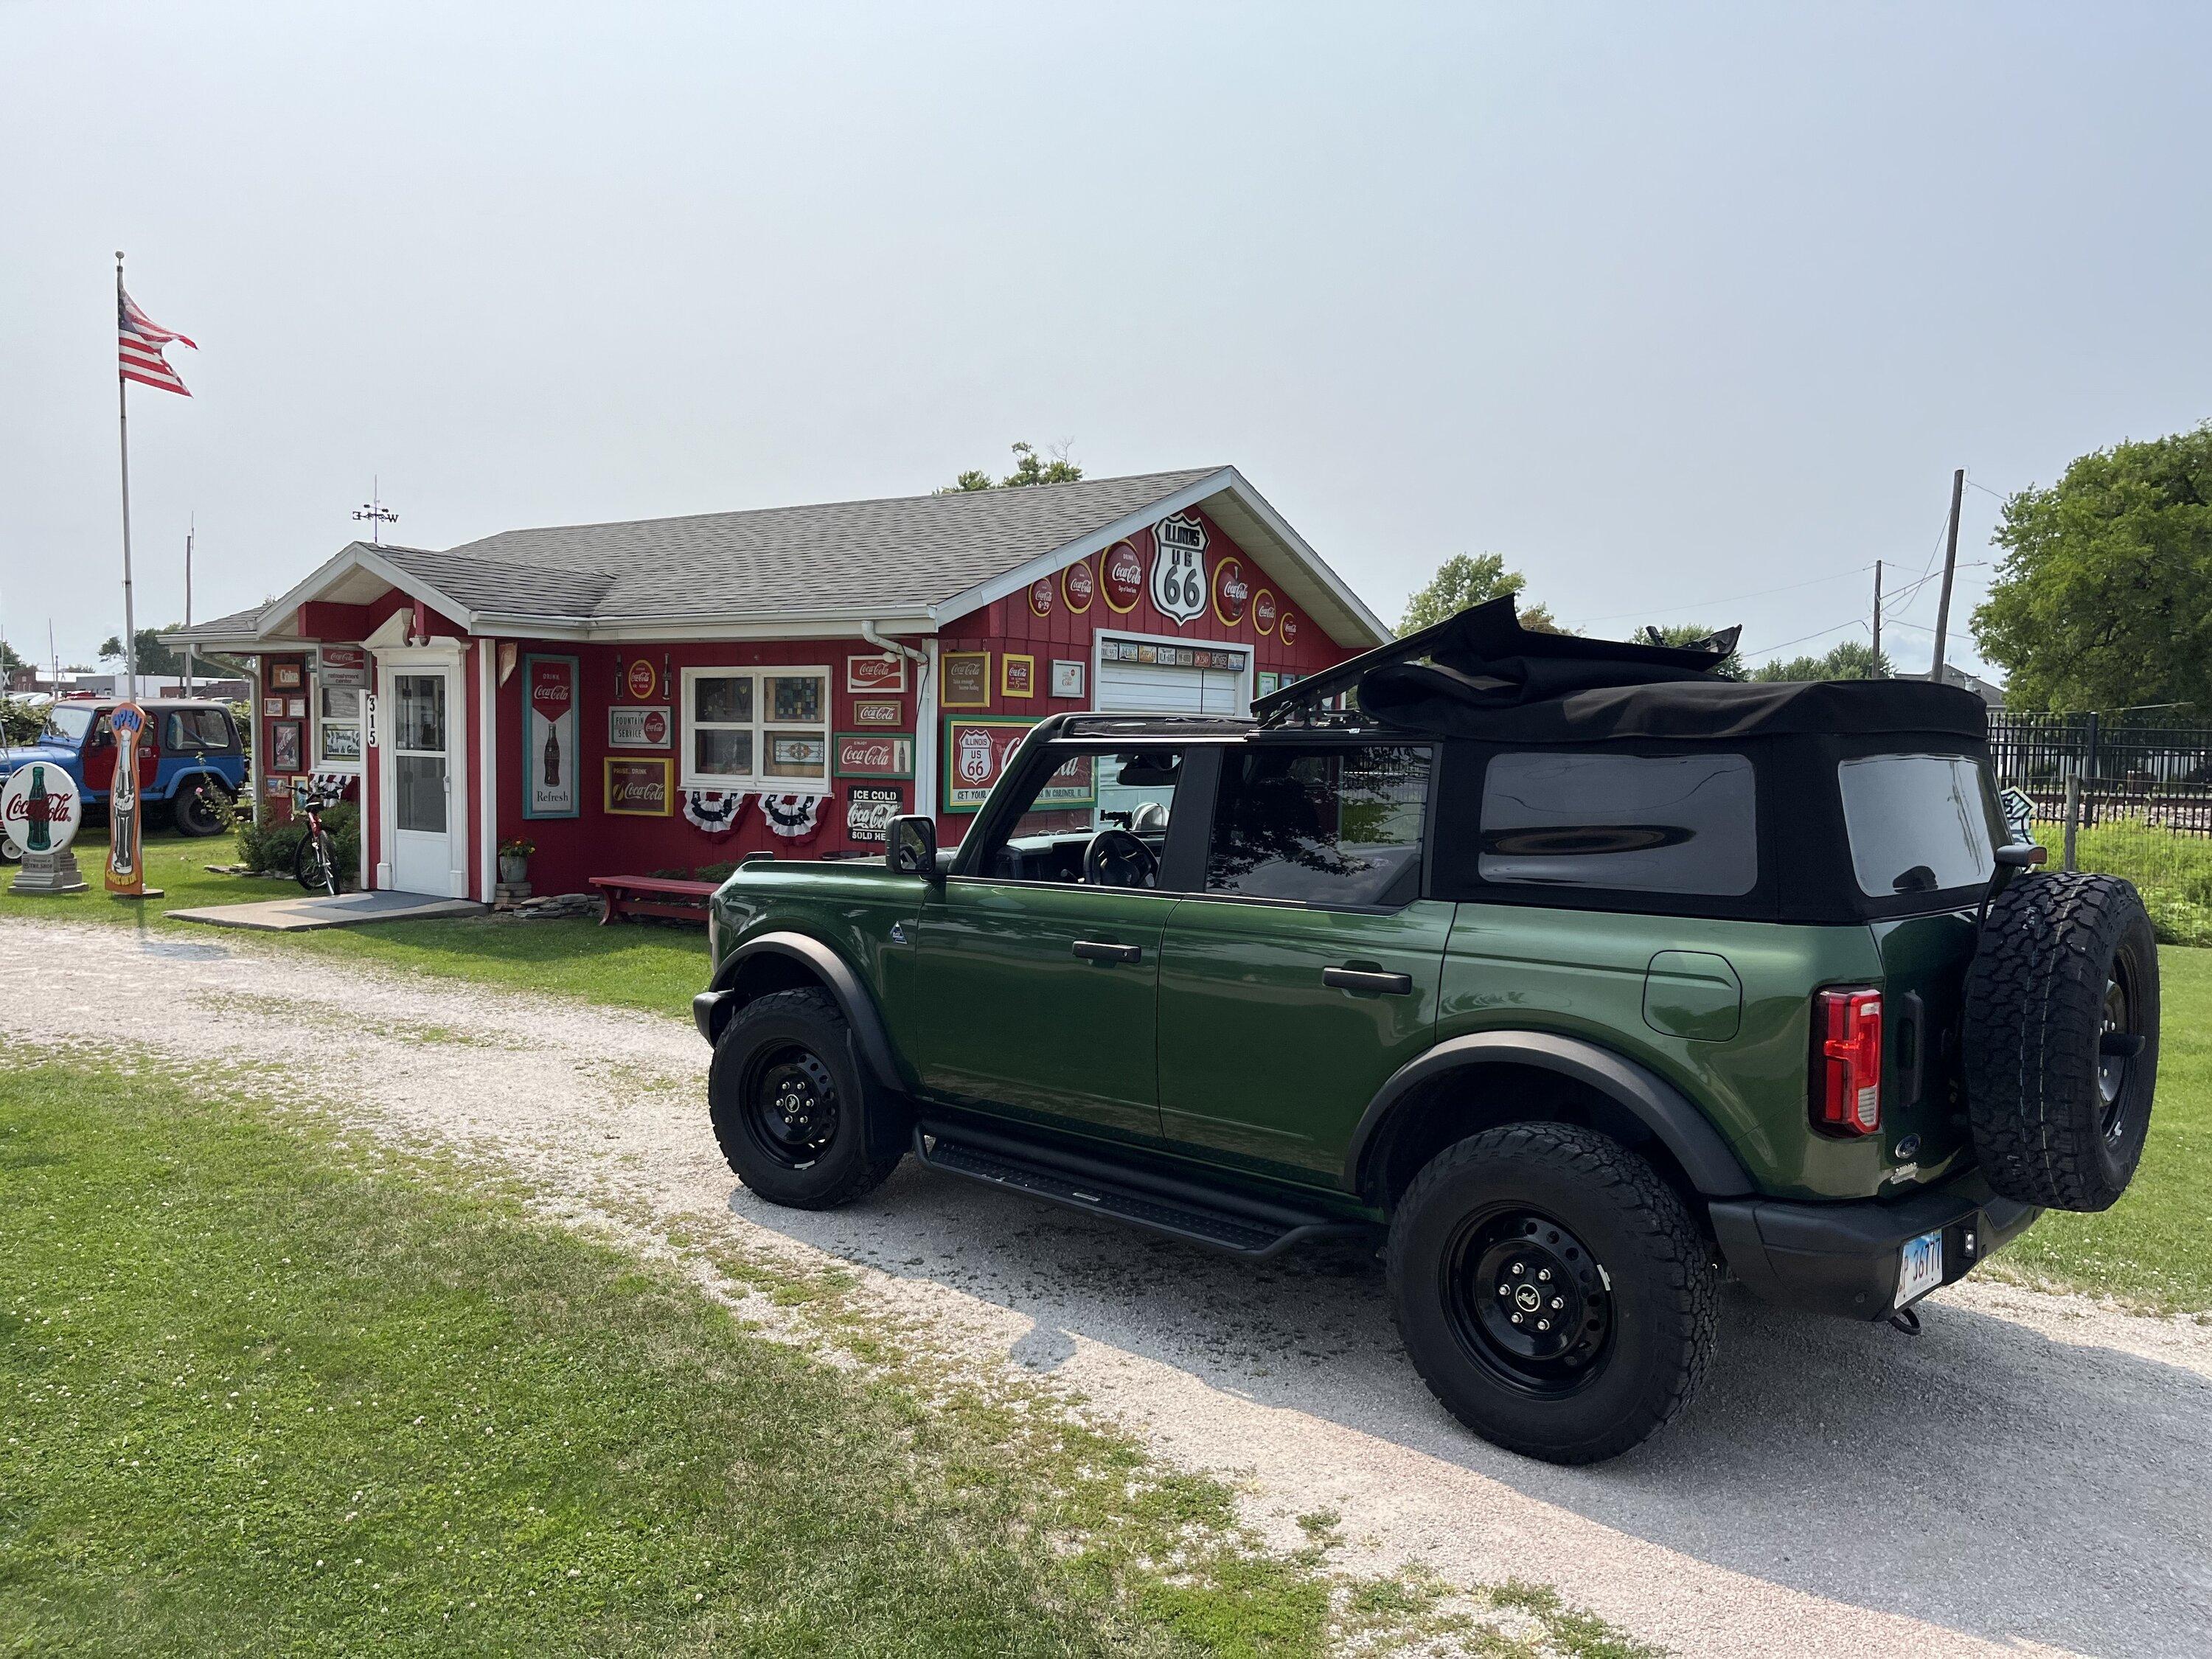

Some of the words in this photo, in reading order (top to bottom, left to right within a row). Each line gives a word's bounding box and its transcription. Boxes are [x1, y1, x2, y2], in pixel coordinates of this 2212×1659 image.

[1166, 524, 1200, 546] ILLINOIS
[1112, 563, 1141, 585] Coca-Cola
[1164, 565, 1200, 608] 66
[860, 663, 890, 676] Coca-Cola
[534, 685, 571, 700] Coca-Cola
[112, 709, 142, 732] OPEN
[860, 706, 896, 720] Coca-Cola
[616, 717, 644, 726] FOUNTAIN
[619, 729, 642, 738] SERVICE
[841, 745, 890, 765] Coca-Cola
[971, 750, 981, 759] US
[967, 761, 984, 776] 66
[537, 790, 569, 803] Refresh
[625, 782, 666, 801] Coca-Cola
[854, 790, 869, 800] ICE
[871, 790, 897, 801] COLD
[958, 791, 968, 799] GET
[971, 790, 986, 799] YOUR
[6, 793, 73, 822] CocCola
[847, 803, 900, 830] Coca-Col
[852, 831, 872, 840] SOLD
[874, 832, 886, 841] HE
[1913, 1237, 1941, 1281] 36777
